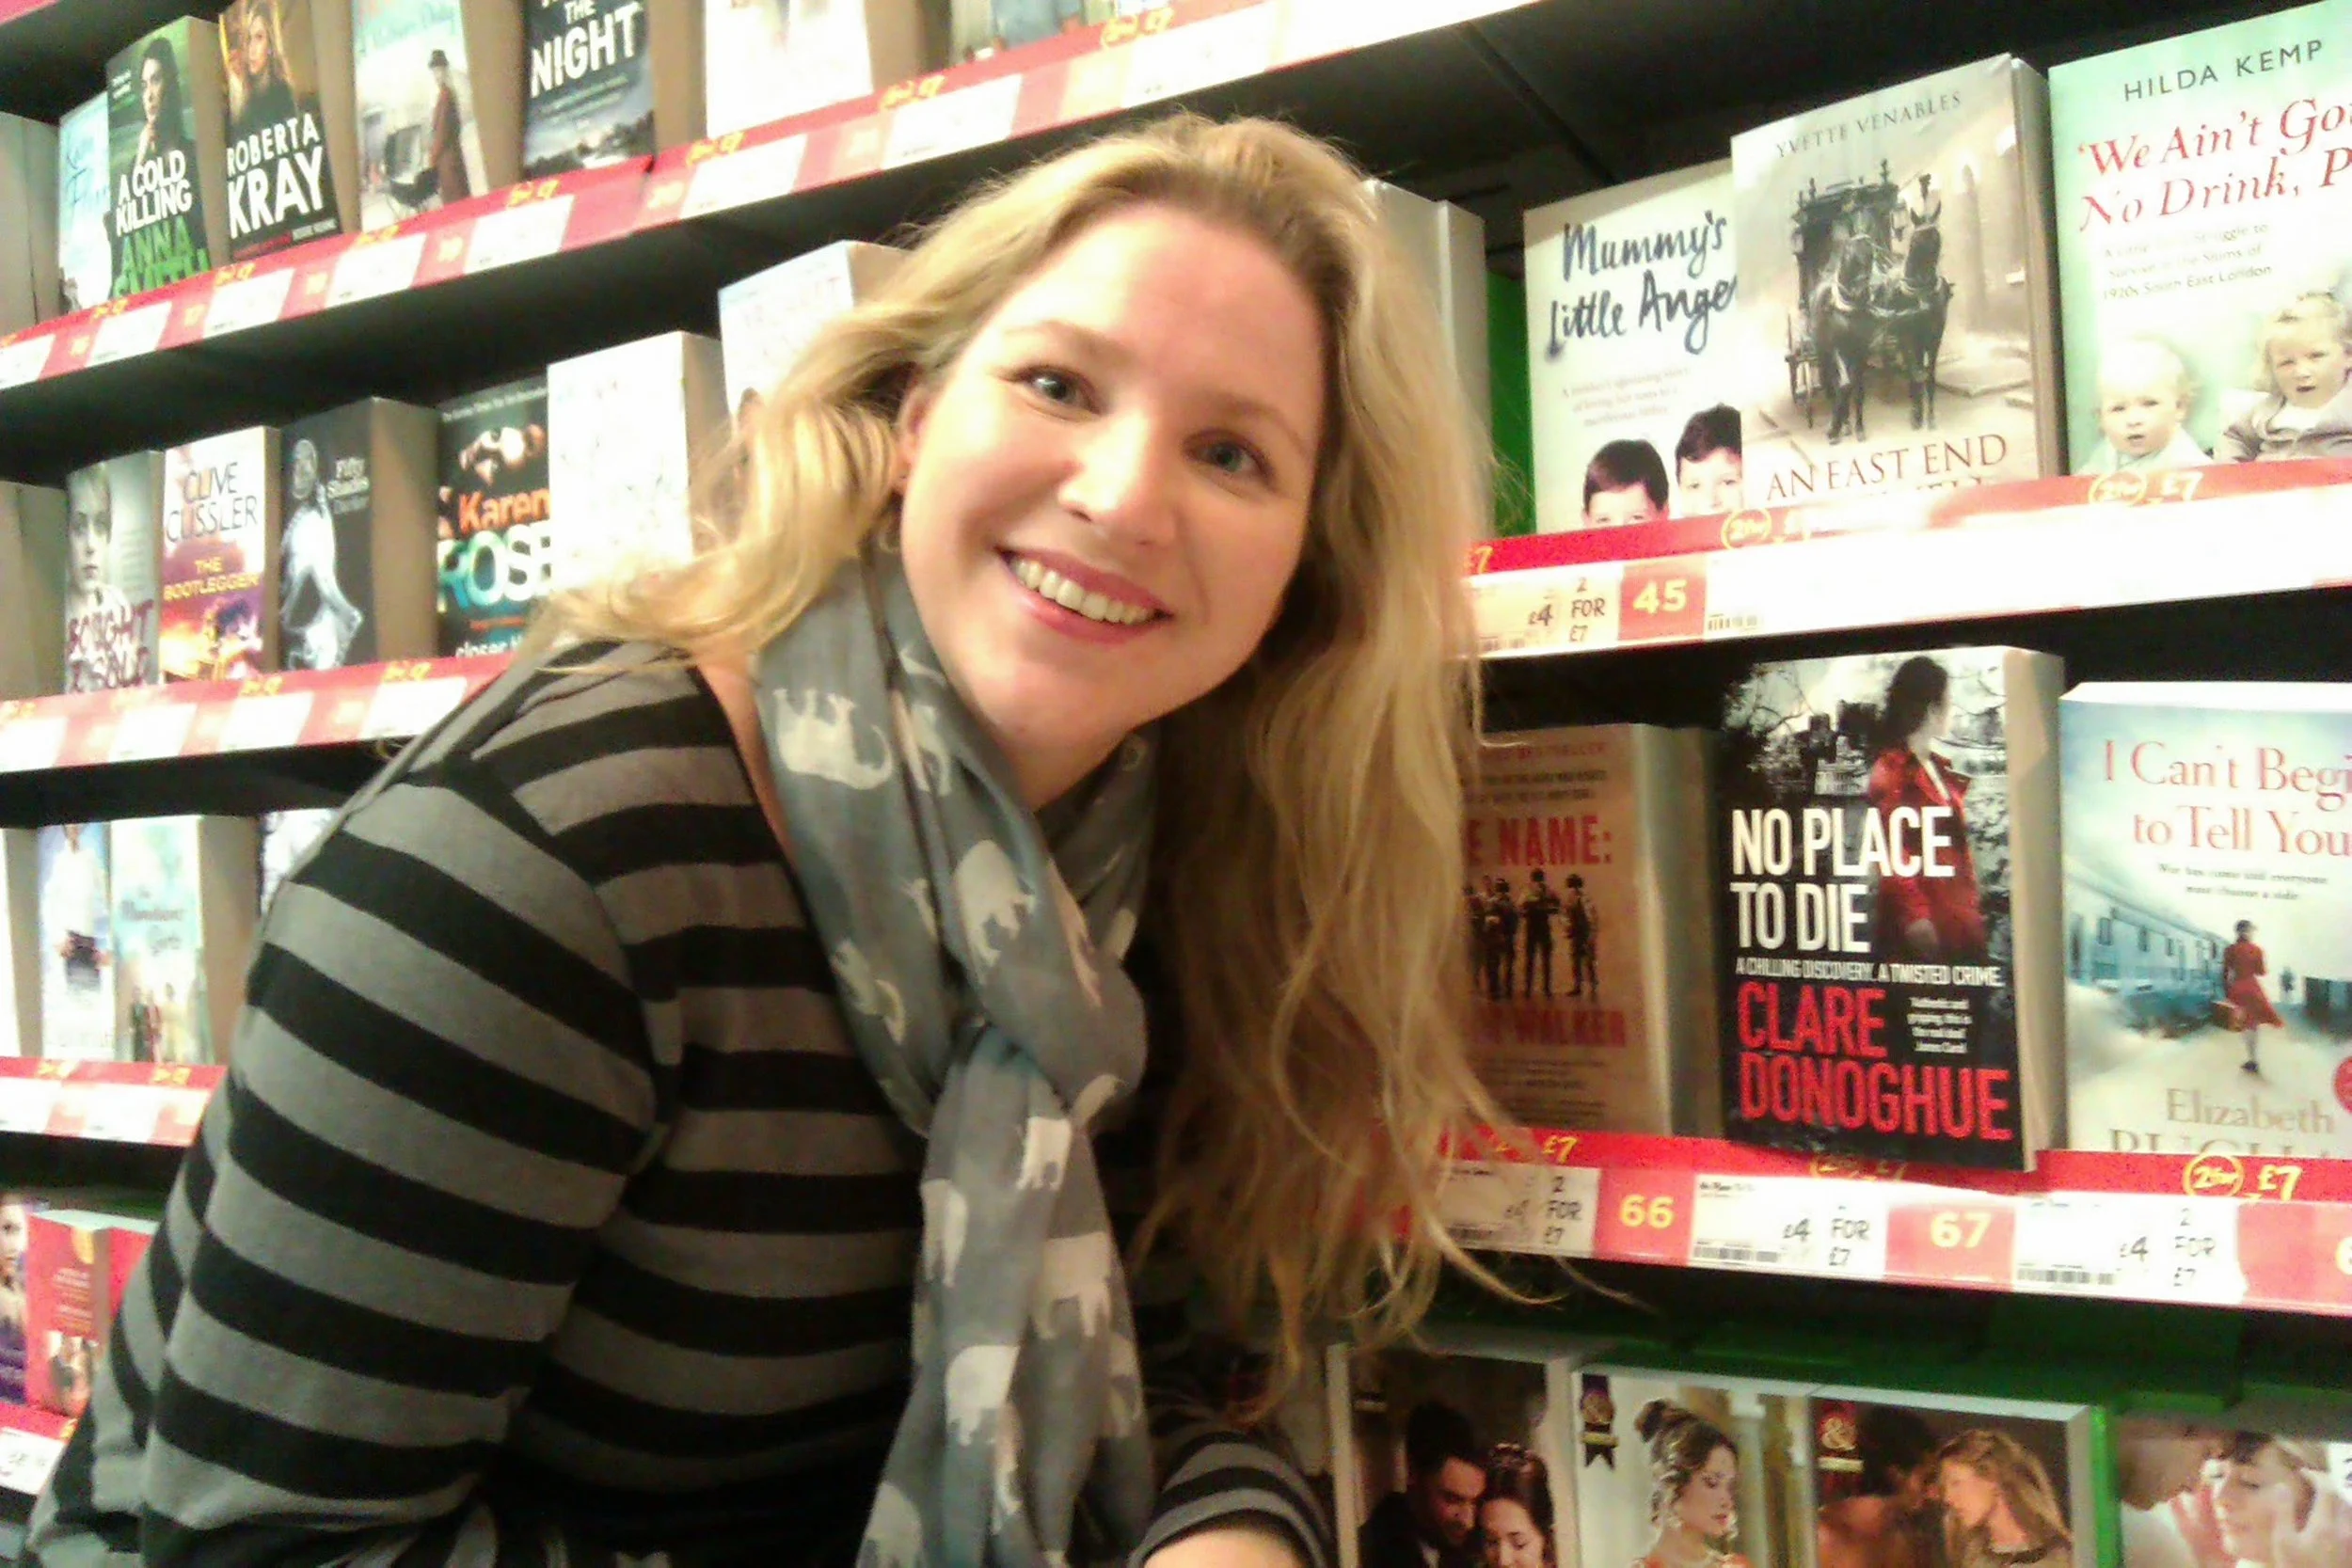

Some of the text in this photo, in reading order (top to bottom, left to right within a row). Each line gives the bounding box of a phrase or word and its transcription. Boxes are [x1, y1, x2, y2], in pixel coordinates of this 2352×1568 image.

[565, 0, 596, 24] THE
[530, 2, 644, 99] NIGHT
[2124, 40, 2323, 102] HILDA KEMP
[227, 114, 320, 177] ROBERTA
[1775, 90, 1963, 158] YVETTE VENABLES
[2280, 98, 2352, 155] Go
[117, 173, 131, 205] A
[133, 149, 187, 198] COLD
[228, 146, 324, 239] KRAY
[2079, 190, 2143, 232] No
[2159, 148, 2299, 216] Drink,
[116, 179, 193, 237] KILLING
[1563, 210, 1727, 282] Mummy's
[1639, 269, 1739, 356] Ange
[183, 461, 239, 503] CLIVE
[1767, 467, 1815, 501] AN
[1825, 448, 1909, 491] EAST
[1923, 434, 2008, 475] END
[166, 495, 259, 543] CUSSLER
[458, 487, 550, 535] Karen
[194, 556, 223, 575] THE
[1571, 597, 1605, 620] FOR
[1633, 579, 1687, 614] 45
[1498, 816, 1613, 866] NAME:
[1731, 806, 1955, 878] NO PLACE
[2135, 805, 2352, 857] to Tell You
[1730, 883, 1871, 953] TO DIE
[1737, 981, 1888, 1059] CLARE
[1739, 1052, 2013, 1142] DONOGHUE
[2167, 1087, 2335, 1134] Elizabeth
[1540, 1134, 1579, 1164] £7
[1547, 1199, 1582, 1220] FOR
[2259, 1164, 2302, 1201] £7
[1619, 1195, 1675, 1229] 66
[1831, 1217, 1870, 1242] FOR
[1930, 1212, 1992, 1248] 67
